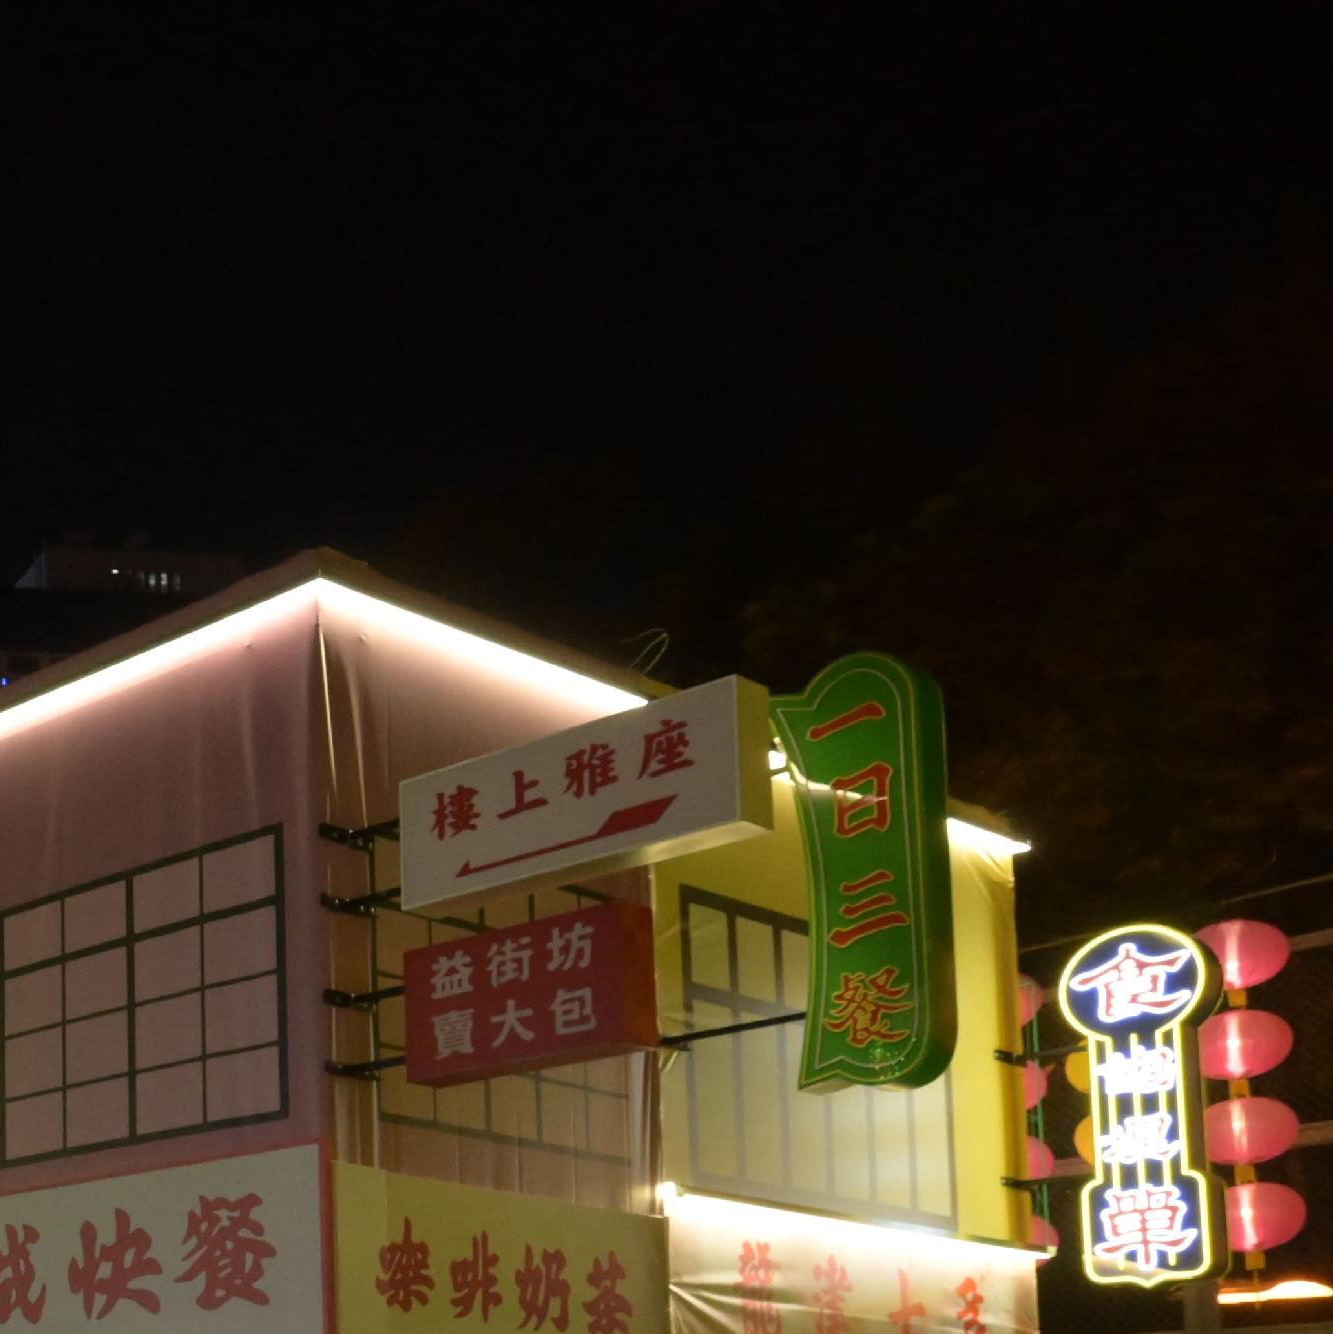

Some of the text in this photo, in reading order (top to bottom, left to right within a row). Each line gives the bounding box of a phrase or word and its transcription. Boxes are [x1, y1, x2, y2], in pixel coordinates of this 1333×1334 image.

[431, 719, 697, 842] 樓上雅座
[806, 701, 914, 1048] 一日三餐
[430, 923, 594, 1000] 益街坊
[431, 987, 598, 1060] 賣大包
